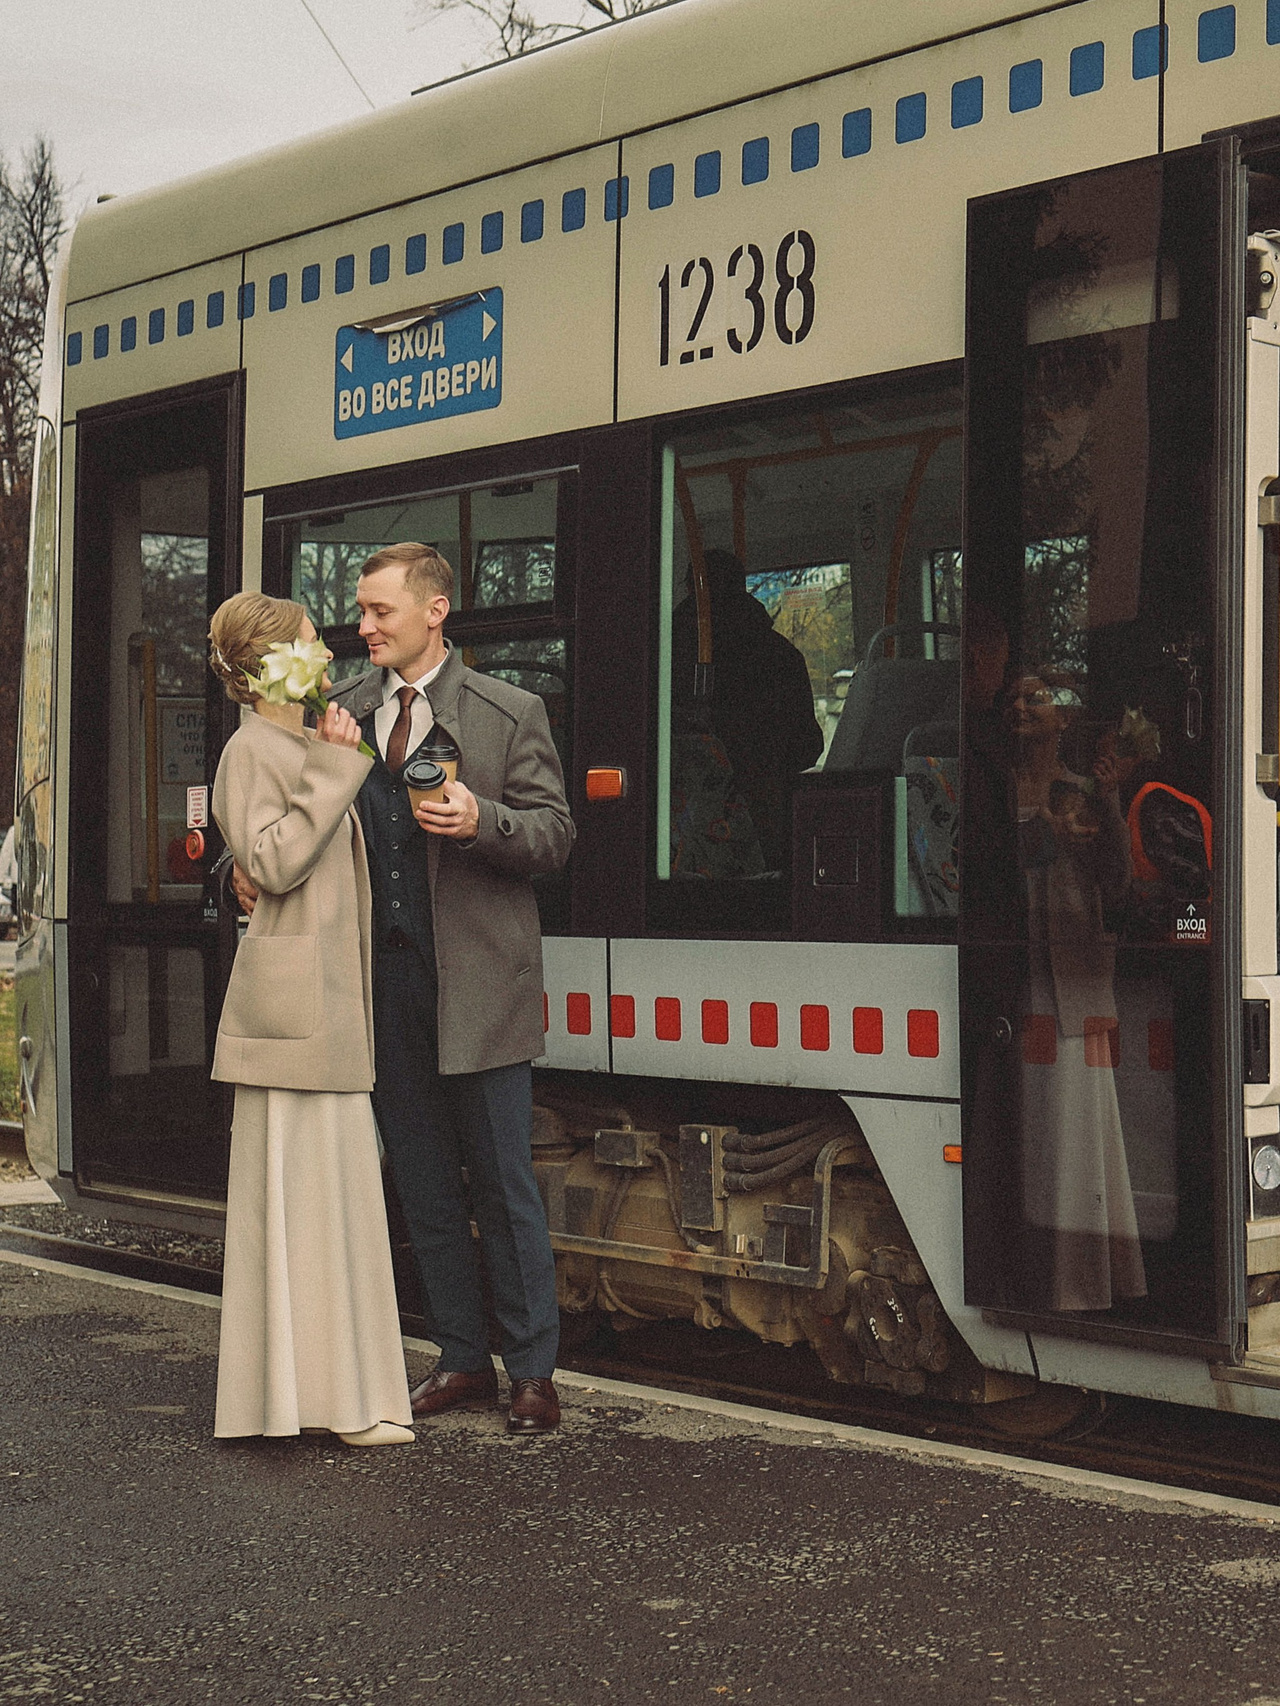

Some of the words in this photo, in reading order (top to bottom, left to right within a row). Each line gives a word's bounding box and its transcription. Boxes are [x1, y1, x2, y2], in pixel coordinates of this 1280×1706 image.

[658, 229, 817, 367] 1238
[387, 320, 446, 365] ВХОД
[338, 385, 366, 422] ВО
[371, 374, 414, 415] ВСЕ
[417, 355, 497, 411] ДВЕРИ
[1176, 918, 1207, 933] ВХОД
[1176, 932, 1206, 940] ENTRANCE
